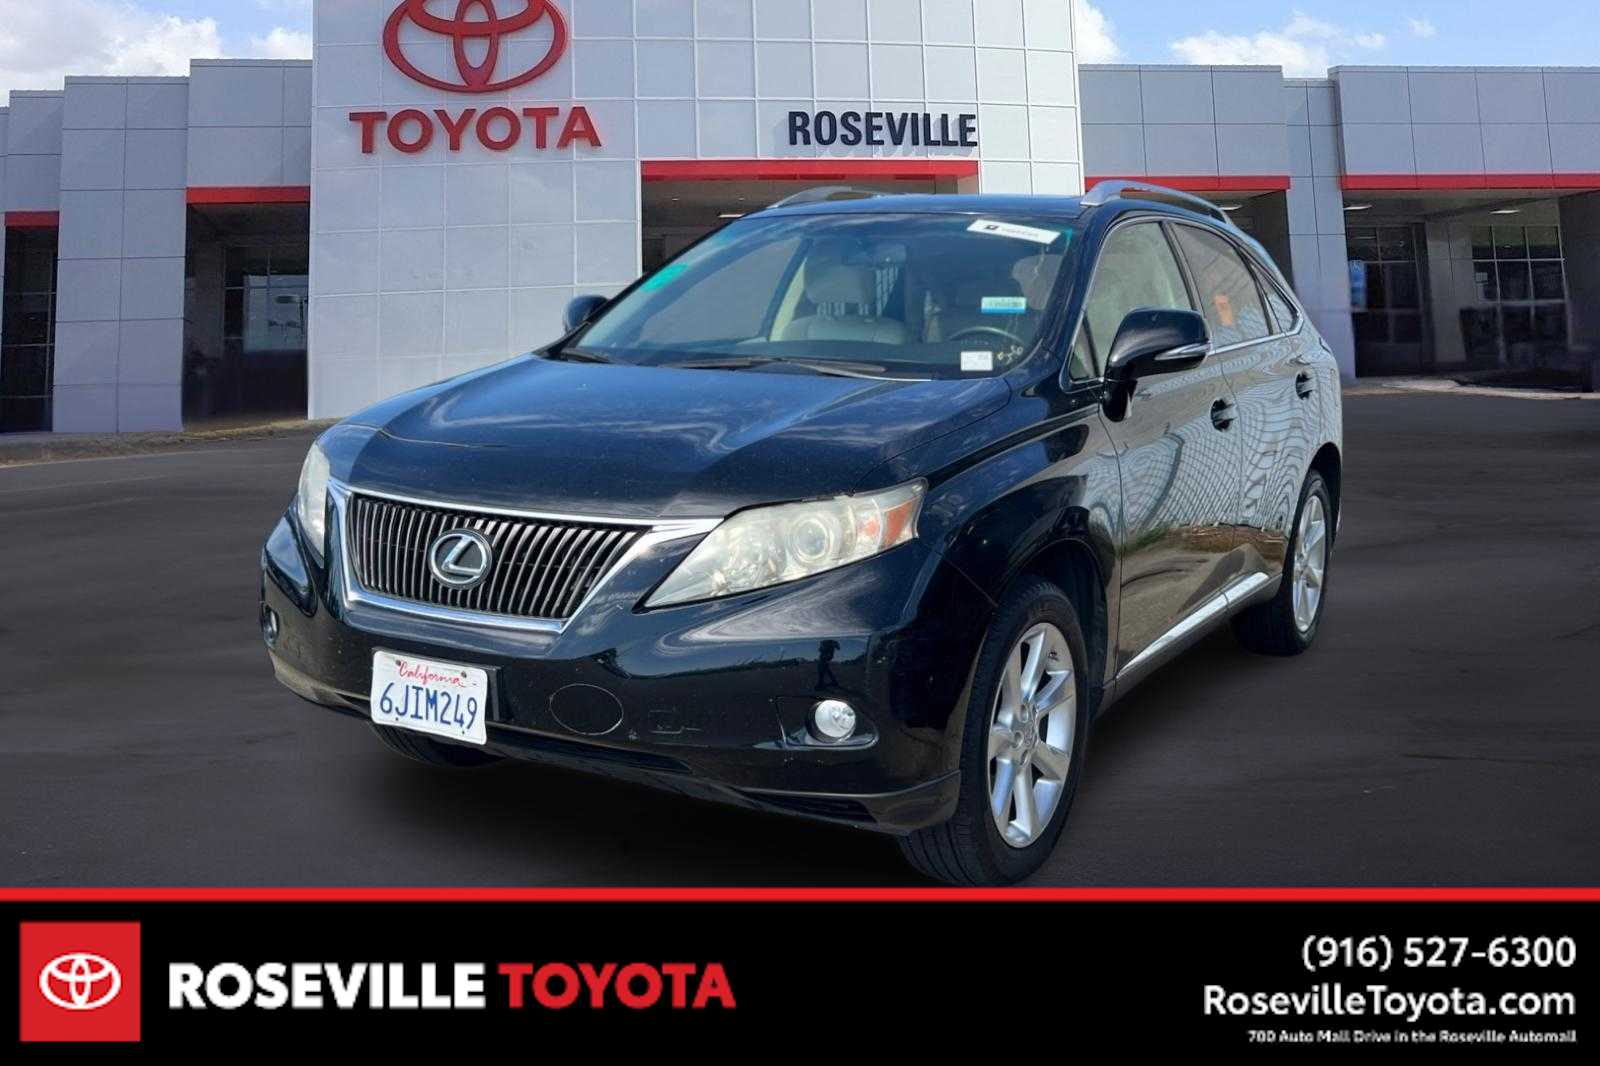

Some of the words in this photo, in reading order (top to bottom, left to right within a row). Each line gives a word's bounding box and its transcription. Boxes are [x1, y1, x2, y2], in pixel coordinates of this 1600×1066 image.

[350, 105, 602, 154] TOYOTA
[789, 111, 978, 147] ROSEVILLE
[399, 661, 465, 687] California
[380, 682, 478, 729] 6JIM249
